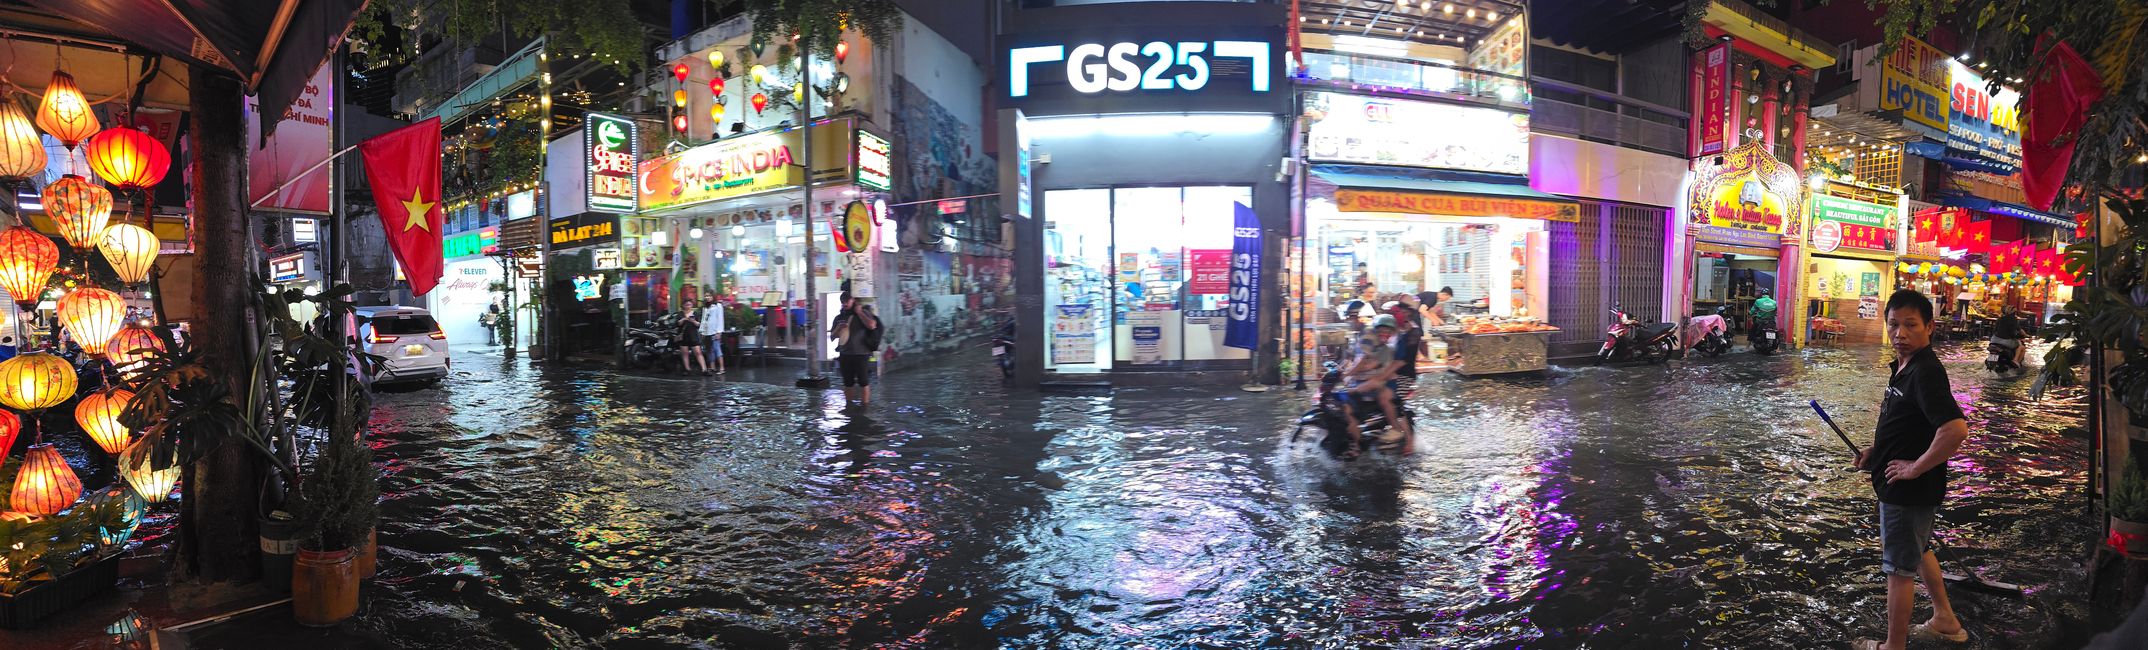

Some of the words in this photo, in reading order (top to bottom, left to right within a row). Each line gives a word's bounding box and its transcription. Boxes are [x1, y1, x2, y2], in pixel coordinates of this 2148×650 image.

[1067, 41, 1210, 93] GS25
[298, 98, 312, 109] ĐÁ
[1709, 66, 1720, 136] INDIAN
[1887, 76, 1945, 124] HOTEL
[1952, 81, 1989, 121] SEN
[303, 114, 329, 126] MINH
[728, 144, 794, 176] INDIA
[1421, 198, 1459, 211] CUA
[1234, 227, 1260, 238] GS25
[1228, 253, 1251, 321] GS25
